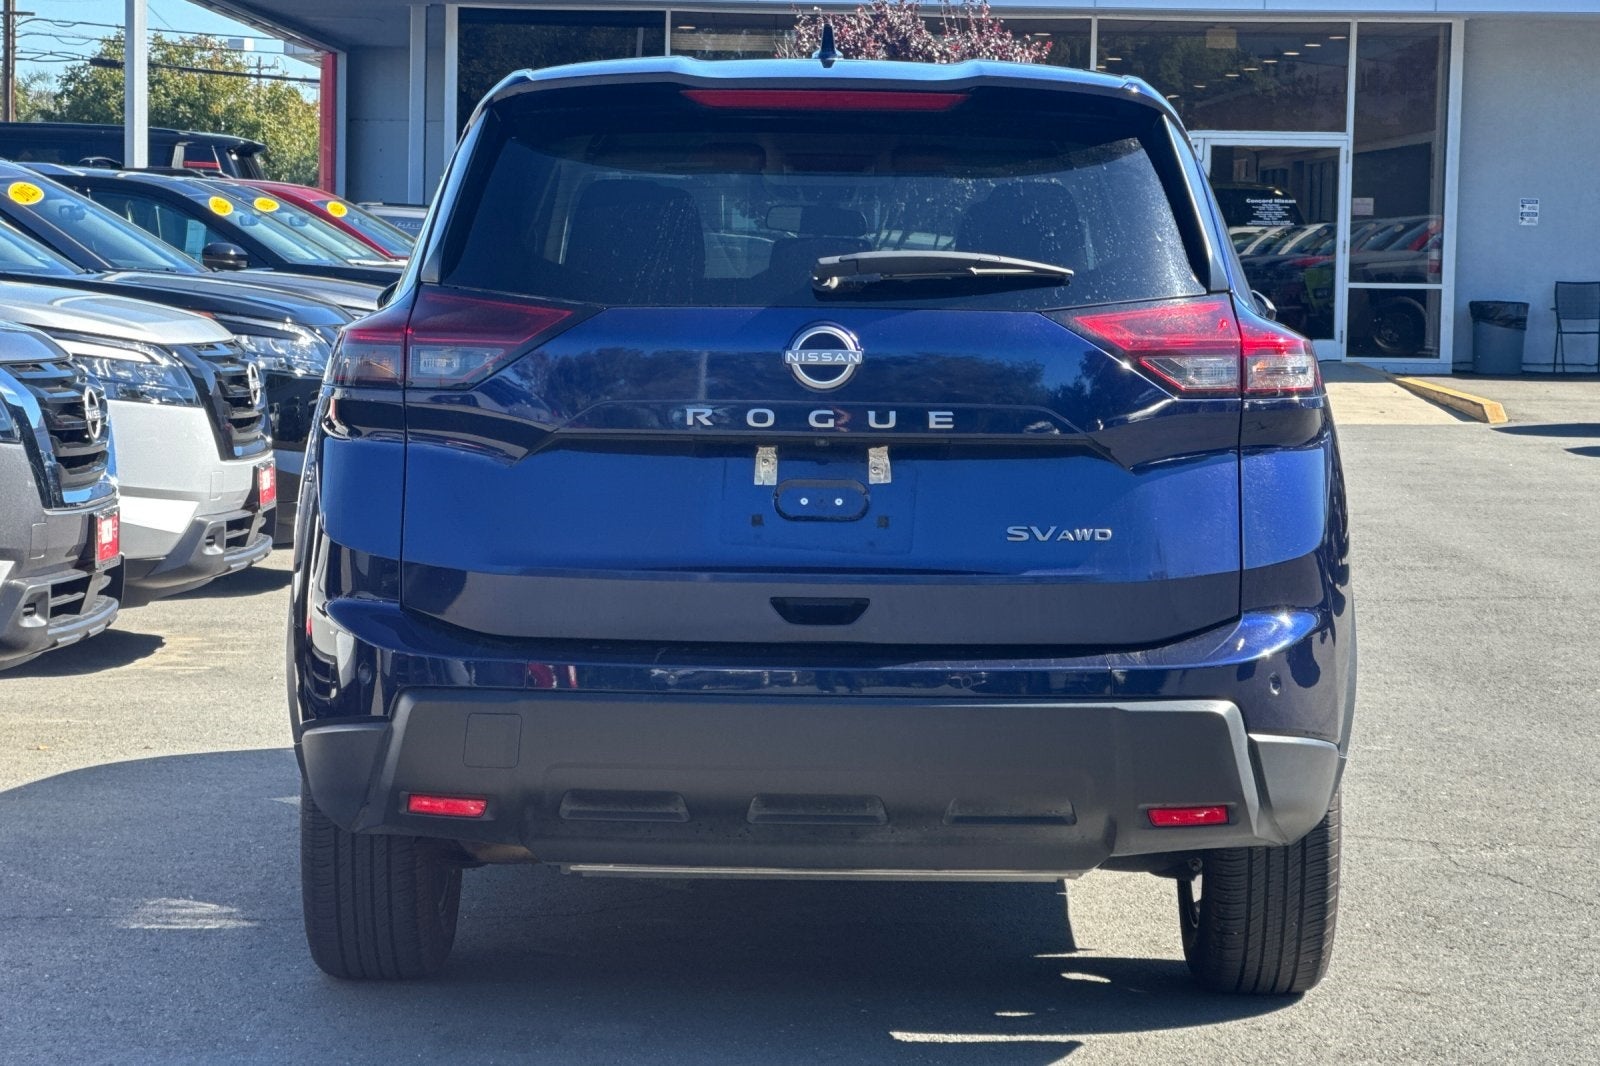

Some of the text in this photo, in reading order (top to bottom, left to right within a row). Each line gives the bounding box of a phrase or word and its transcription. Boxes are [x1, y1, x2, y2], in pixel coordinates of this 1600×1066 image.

[787, 351, 860, 363] NISSAN
[686, 408, 955, 429] ROGUE
[1006, 525, 1112, 542] SV AWD
